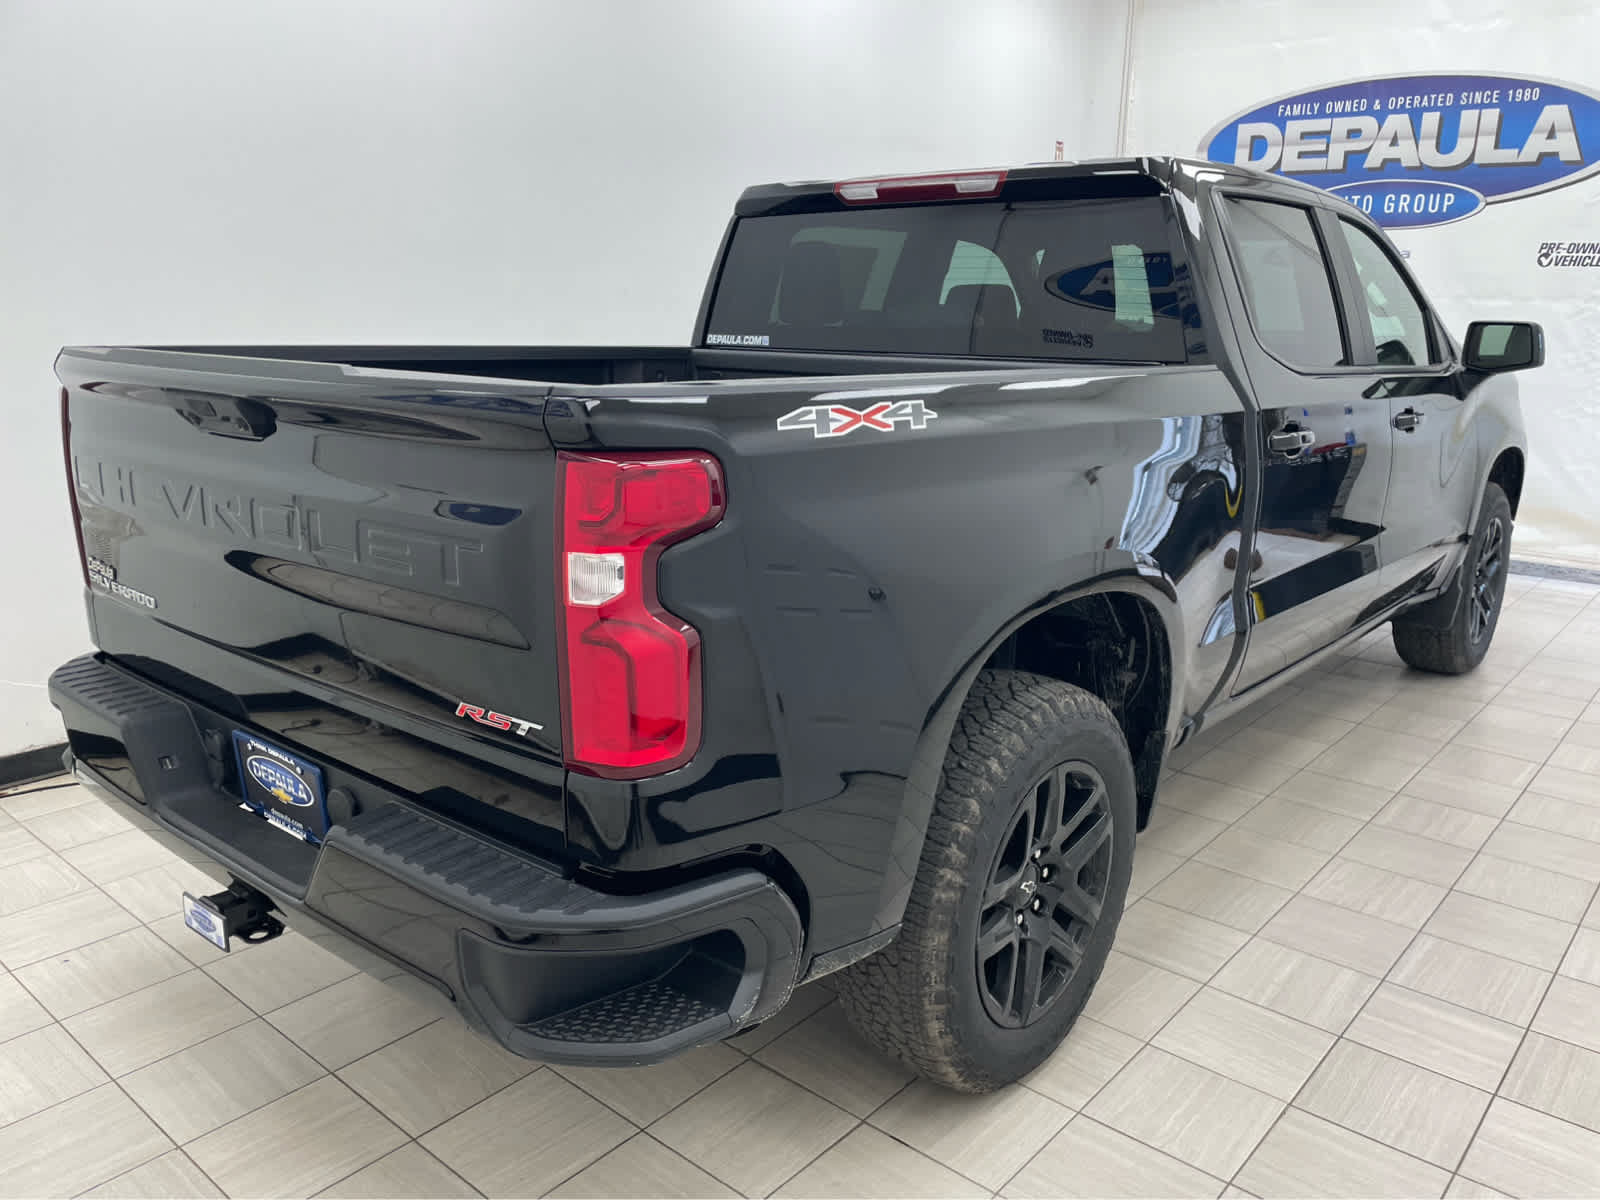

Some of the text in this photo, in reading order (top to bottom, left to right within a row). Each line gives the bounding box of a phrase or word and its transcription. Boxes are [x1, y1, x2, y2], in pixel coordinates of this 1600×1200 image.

[1278, 87, 1540, 118] FAMILY OWNED & OPERATED SINCE 1980
[1234, 104, 1582, 173] DEPAULA
[1344, 193, 1456, 214] TO GROUP
[706, 334, 762, 345] DEPAULA.COM
[74, 455, 484, 586] CHVROLET
[89, 570, 155, 608] SILVERADO
[456, 702, 544, 736] RST
[252, 760, 308, 803] DEPAULA
